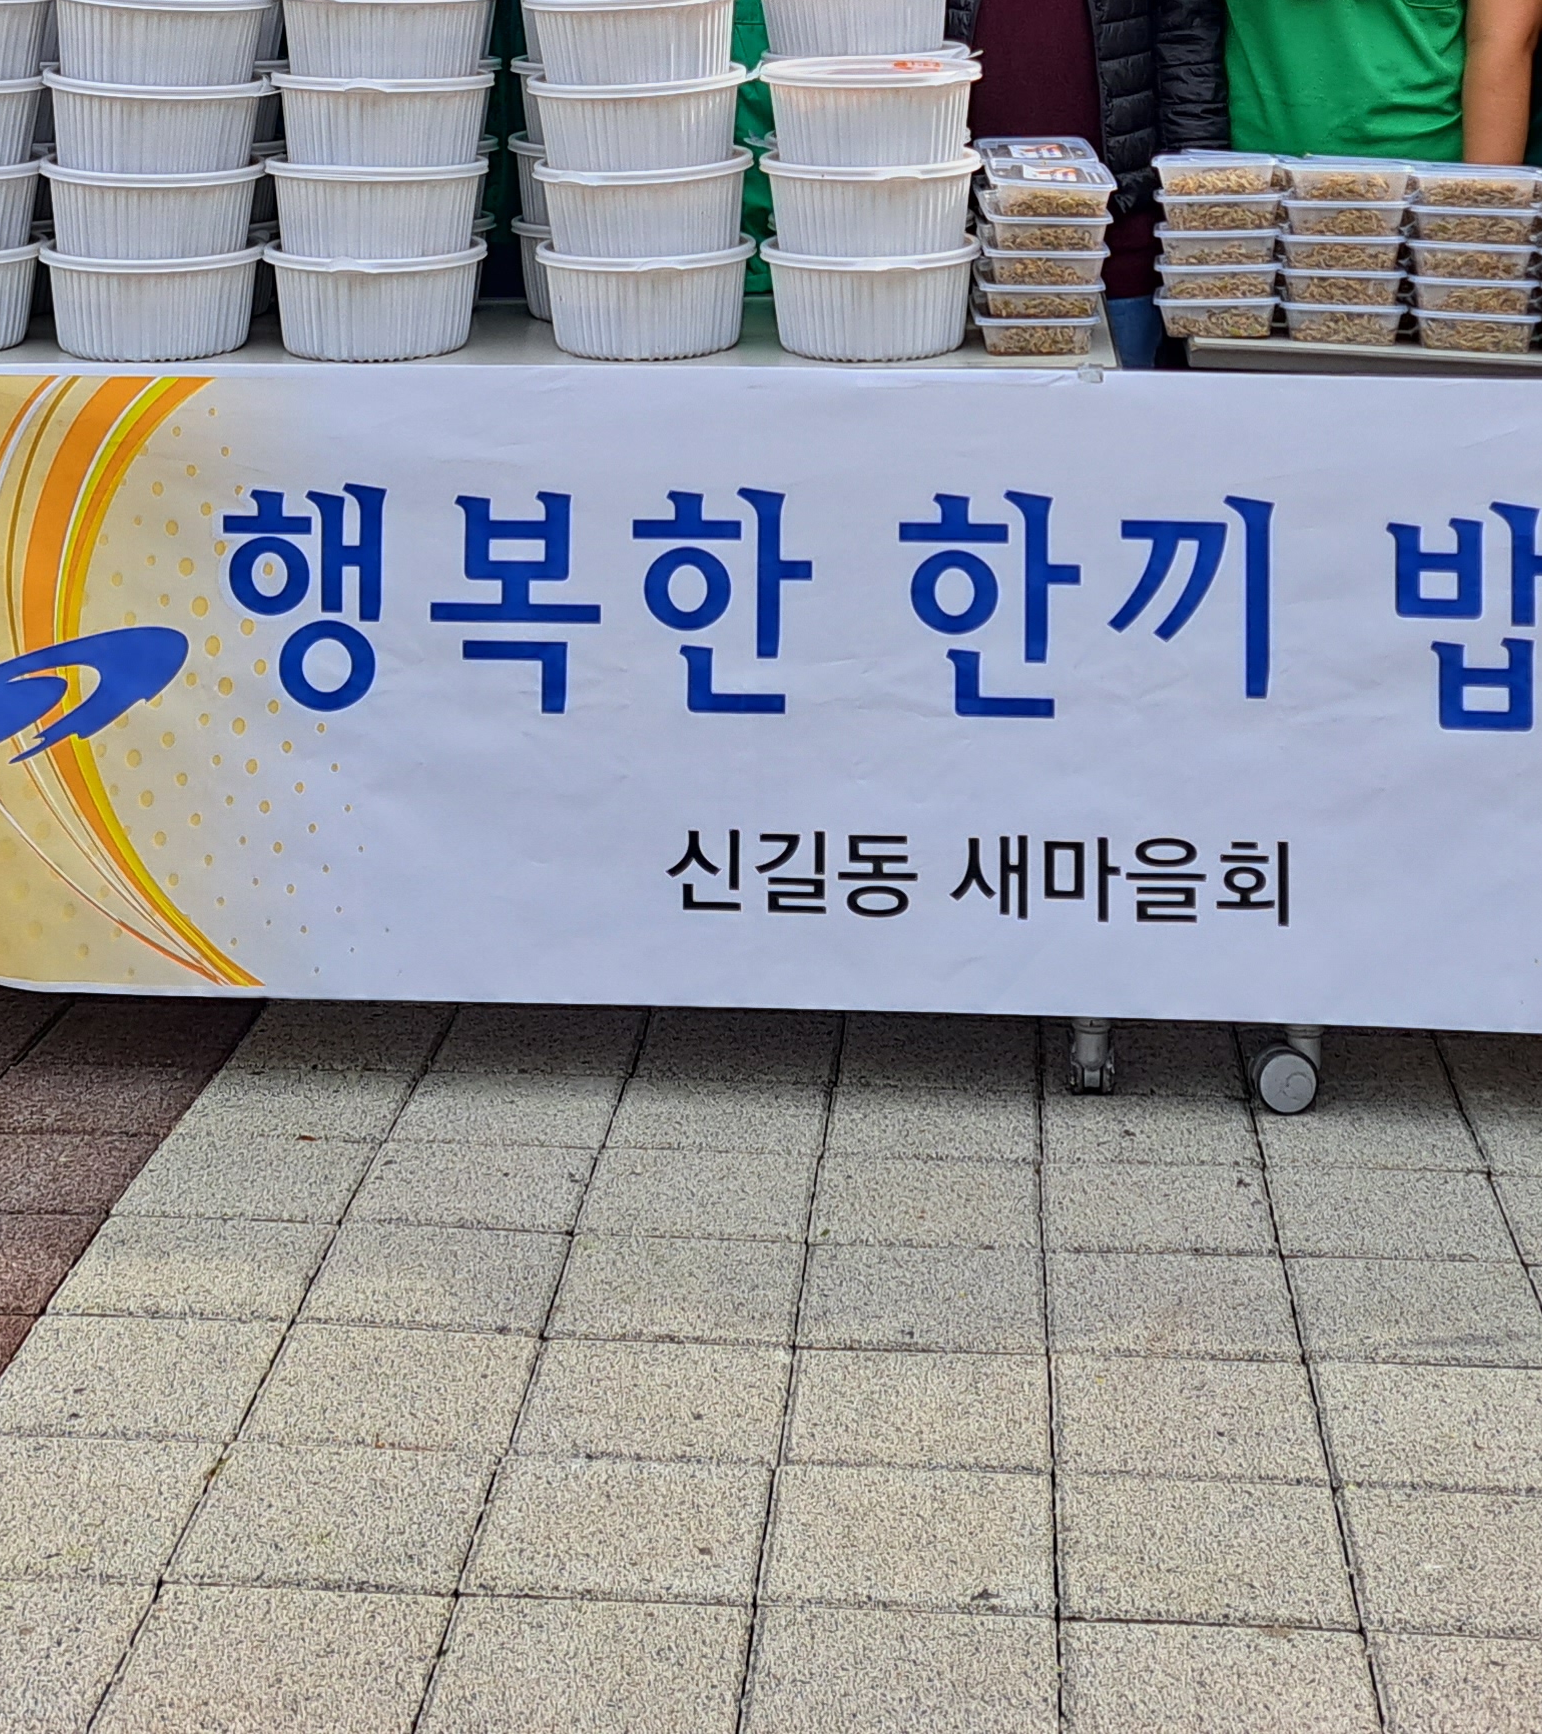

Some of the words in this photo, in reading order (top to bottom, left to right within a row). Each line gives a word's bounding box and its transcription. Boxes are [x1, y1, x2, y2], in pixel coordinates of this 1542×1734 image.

[223, 483, 813, 718] 행복한
[899, 490, 1272, 719] 한끼
[666, 829, 919, 920] 신길동
[949, 833, 1290, 928] 새마을회
